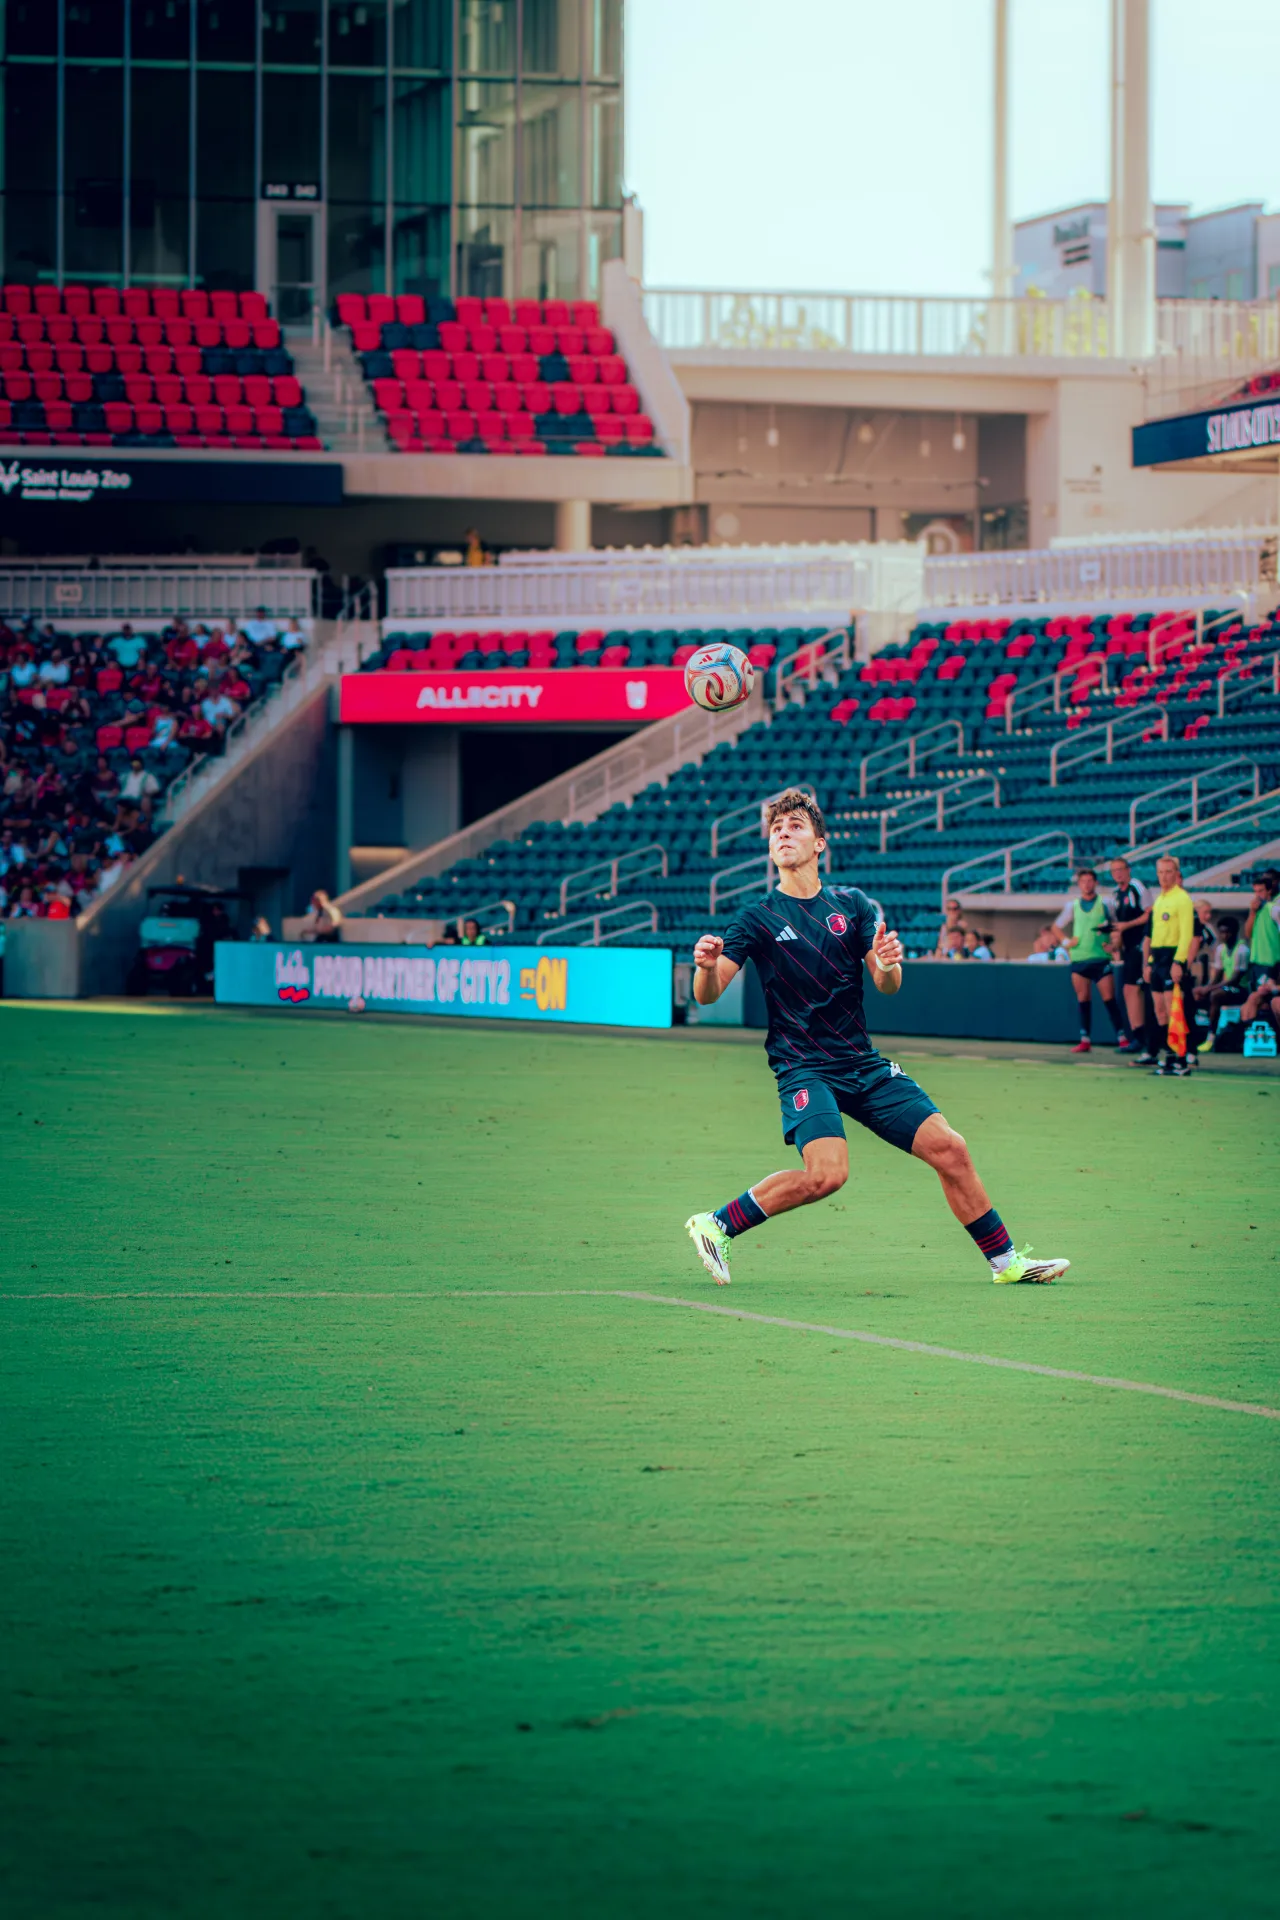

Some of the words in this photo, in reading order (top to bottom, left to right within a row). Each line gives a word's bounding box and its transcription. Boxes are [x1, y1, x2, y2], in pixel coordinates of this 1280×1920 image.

[1222, 410, 1252, 450] LOUIS
[22, 468, 58, 487] Saint
[61, 468, 99, 487] Louis
[101, 469, 131, 489] Zoo
[313, 954, 362, 998] PROUD
[363, 956, 436, 1002] PARTNER
[437, 958, 460, 1003] OF
[460, 958, 511, 1005] CITY2
